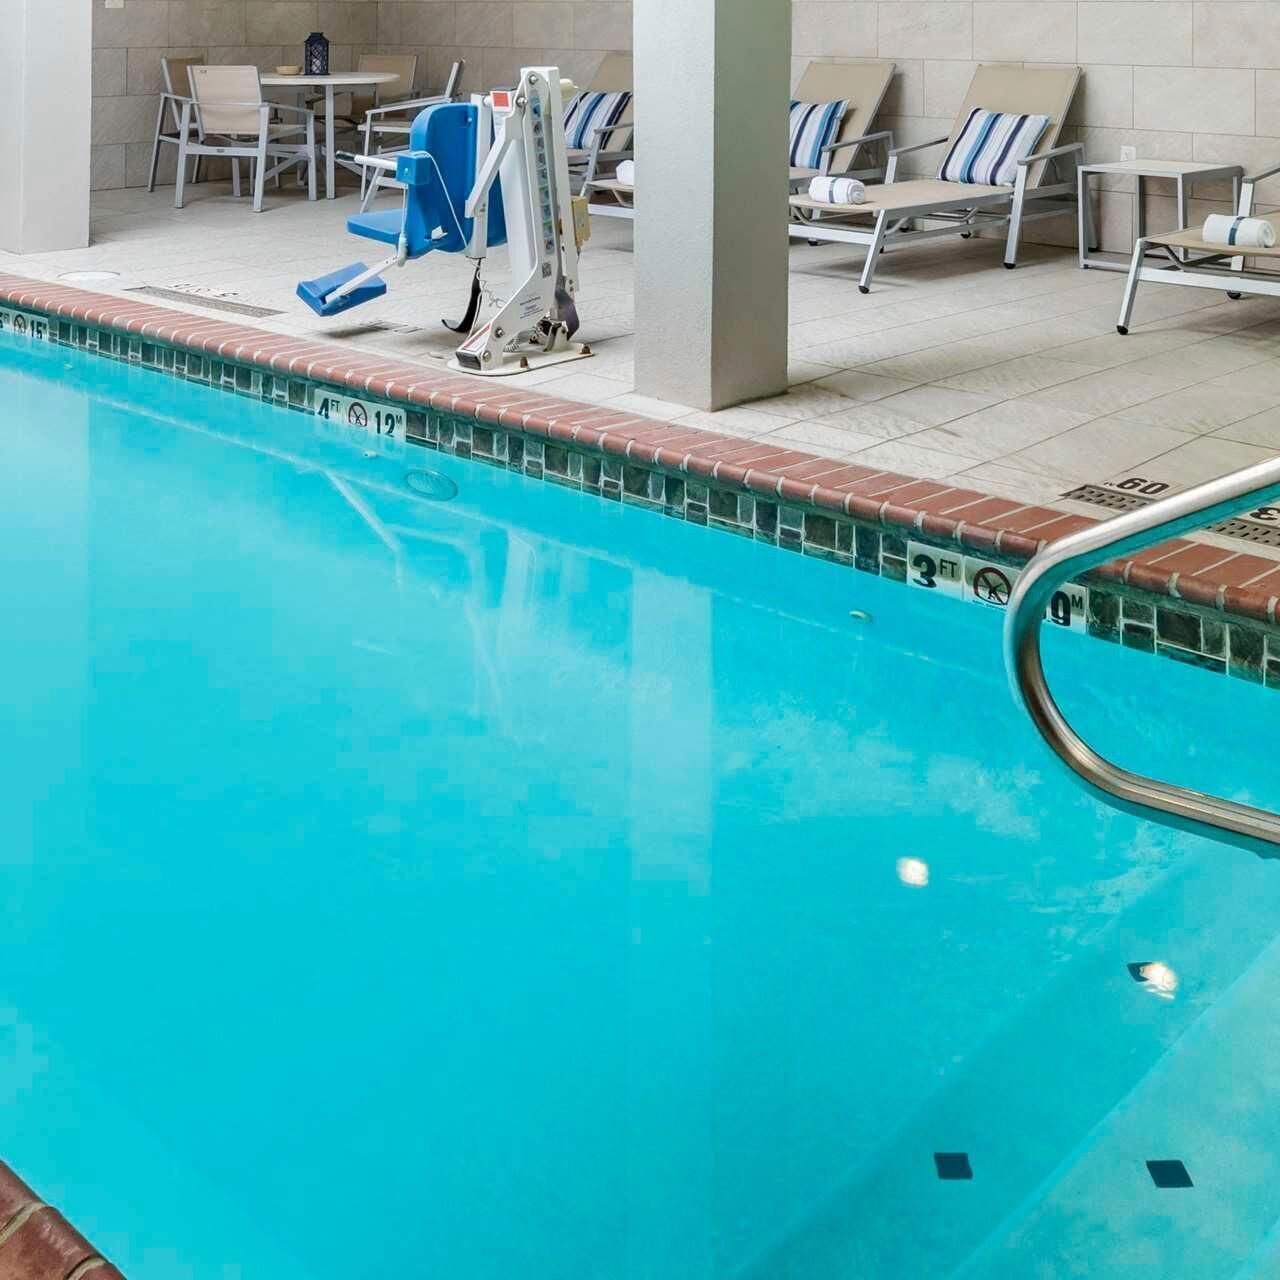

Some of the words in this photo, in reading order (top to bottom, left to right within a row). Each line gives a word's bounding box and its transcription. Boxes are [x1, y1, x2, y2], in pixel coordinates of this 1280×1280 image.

[318, 398, 329, 419] 4
[913, 554, 937, 588] 3
[940, 559, 958, 578] FT
[1071, 594, 1083, 610] M
